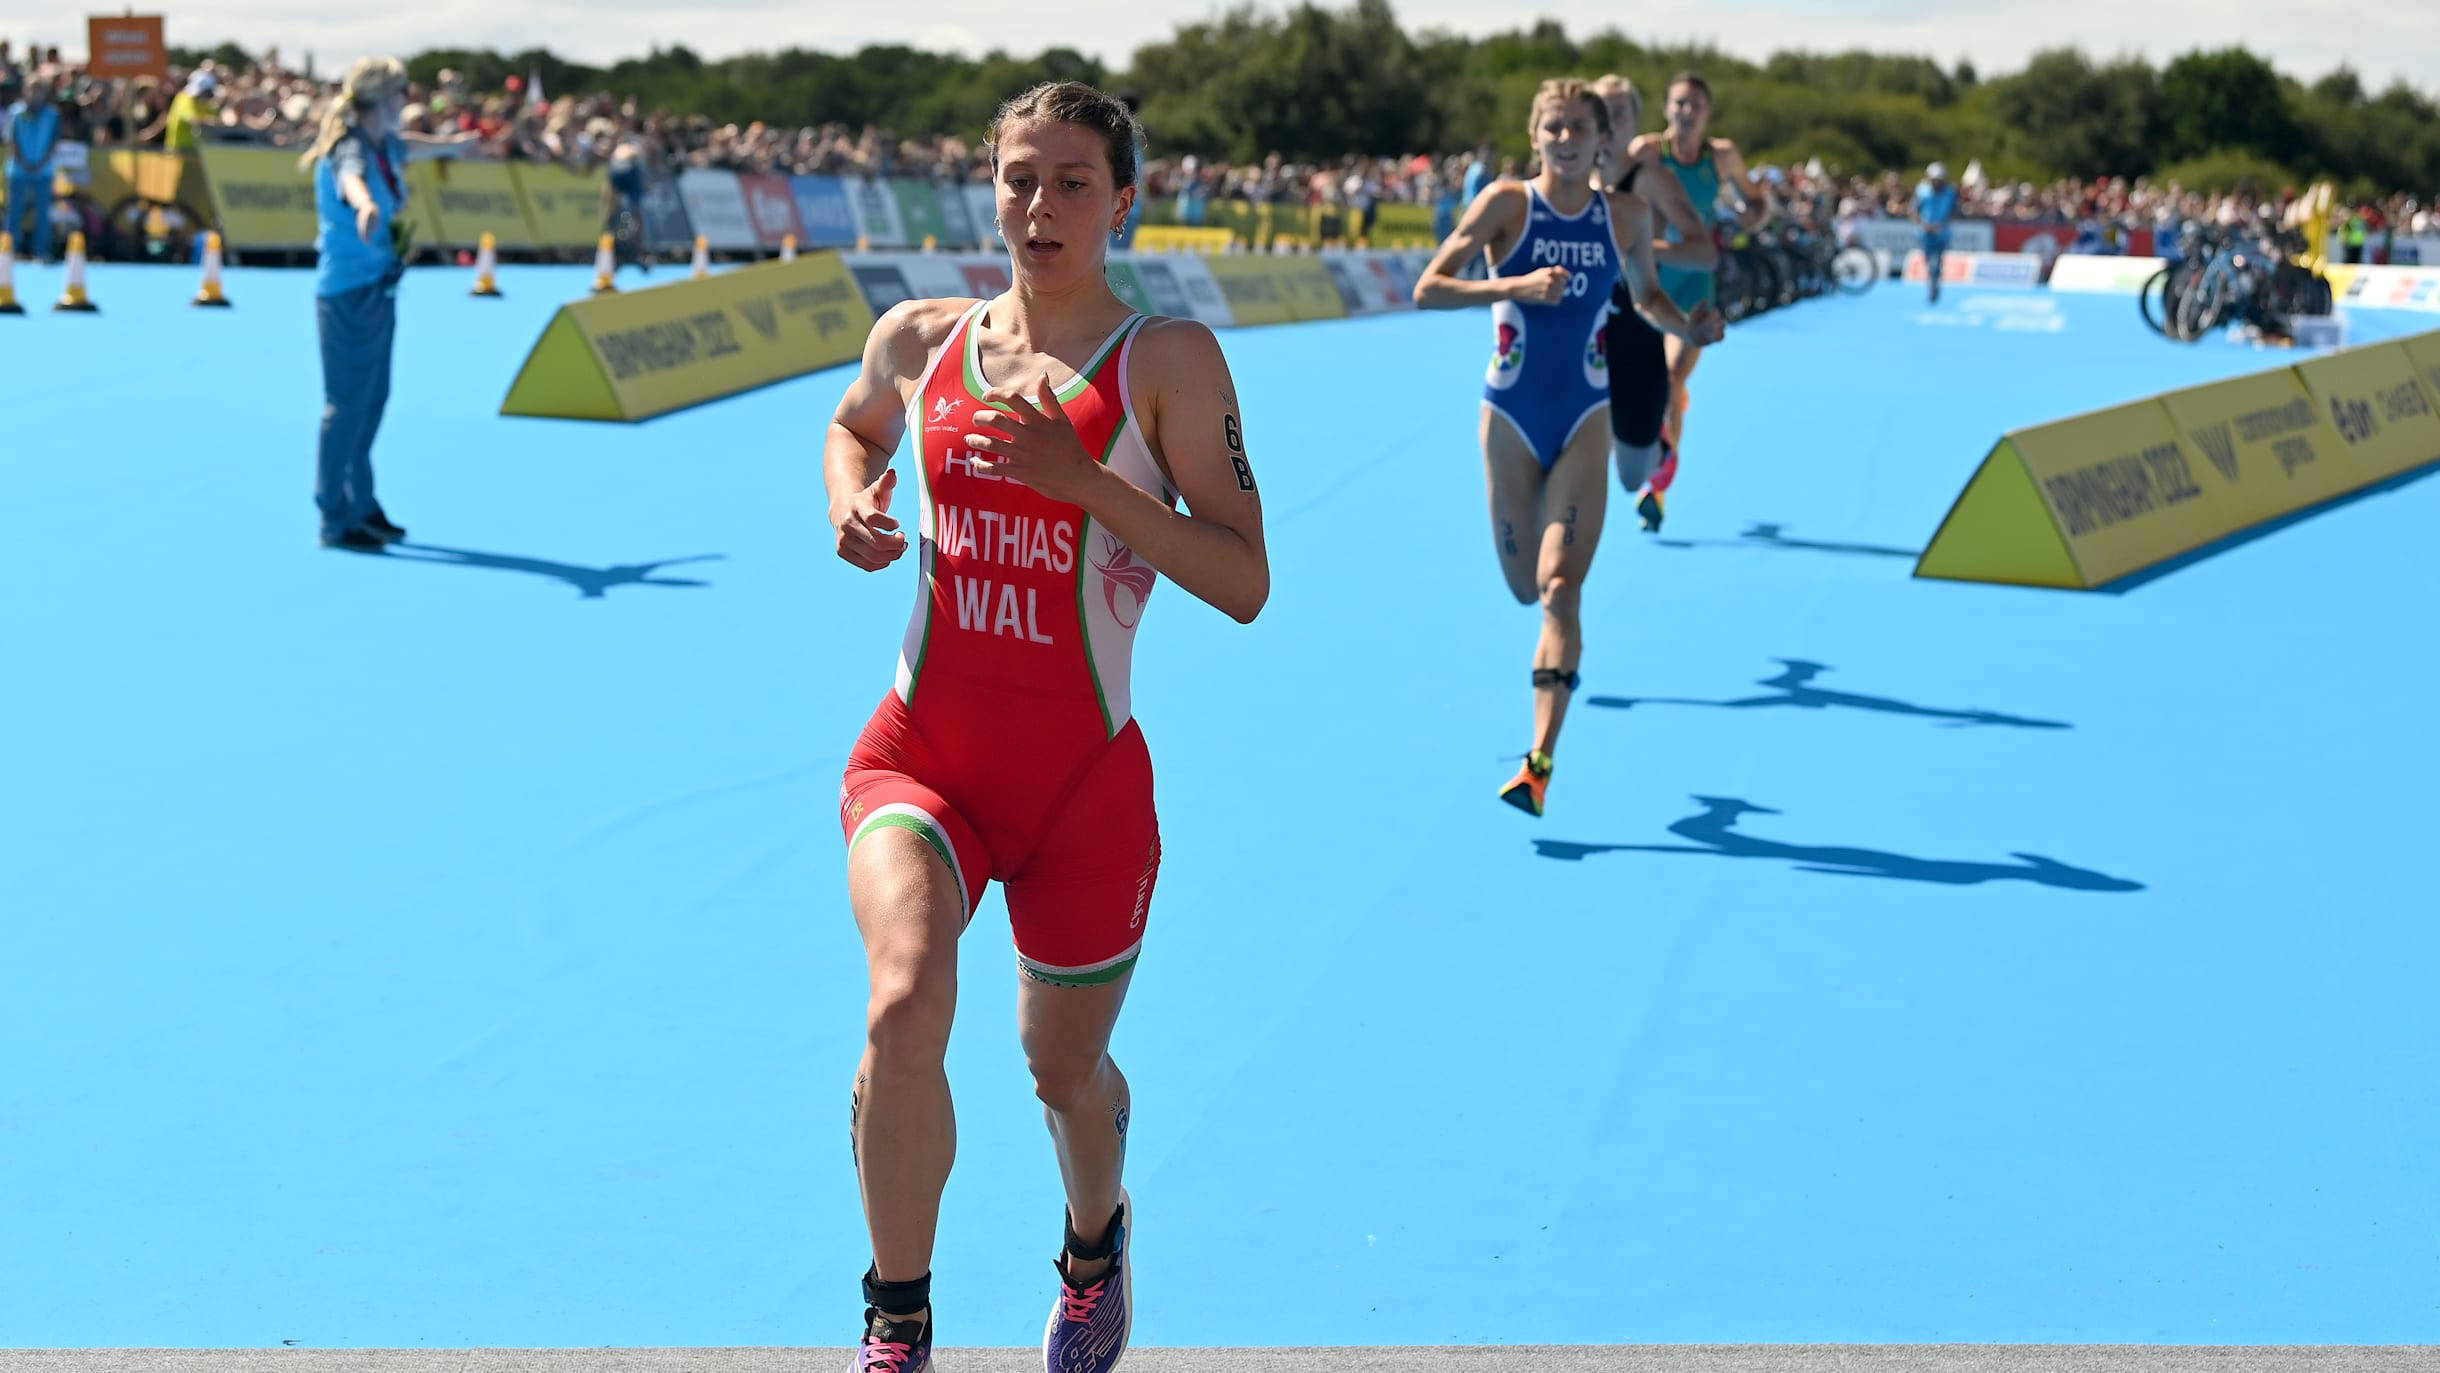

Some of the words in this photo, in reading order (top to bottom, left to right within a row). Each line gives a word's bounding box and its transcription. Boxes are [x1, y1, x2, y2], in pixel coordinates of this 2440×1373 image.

[1531, 238, 1607, 267] POTTER
[937, 503, 1074, 574] MATHIAS
[954, 574, 1054, 645] WAL
